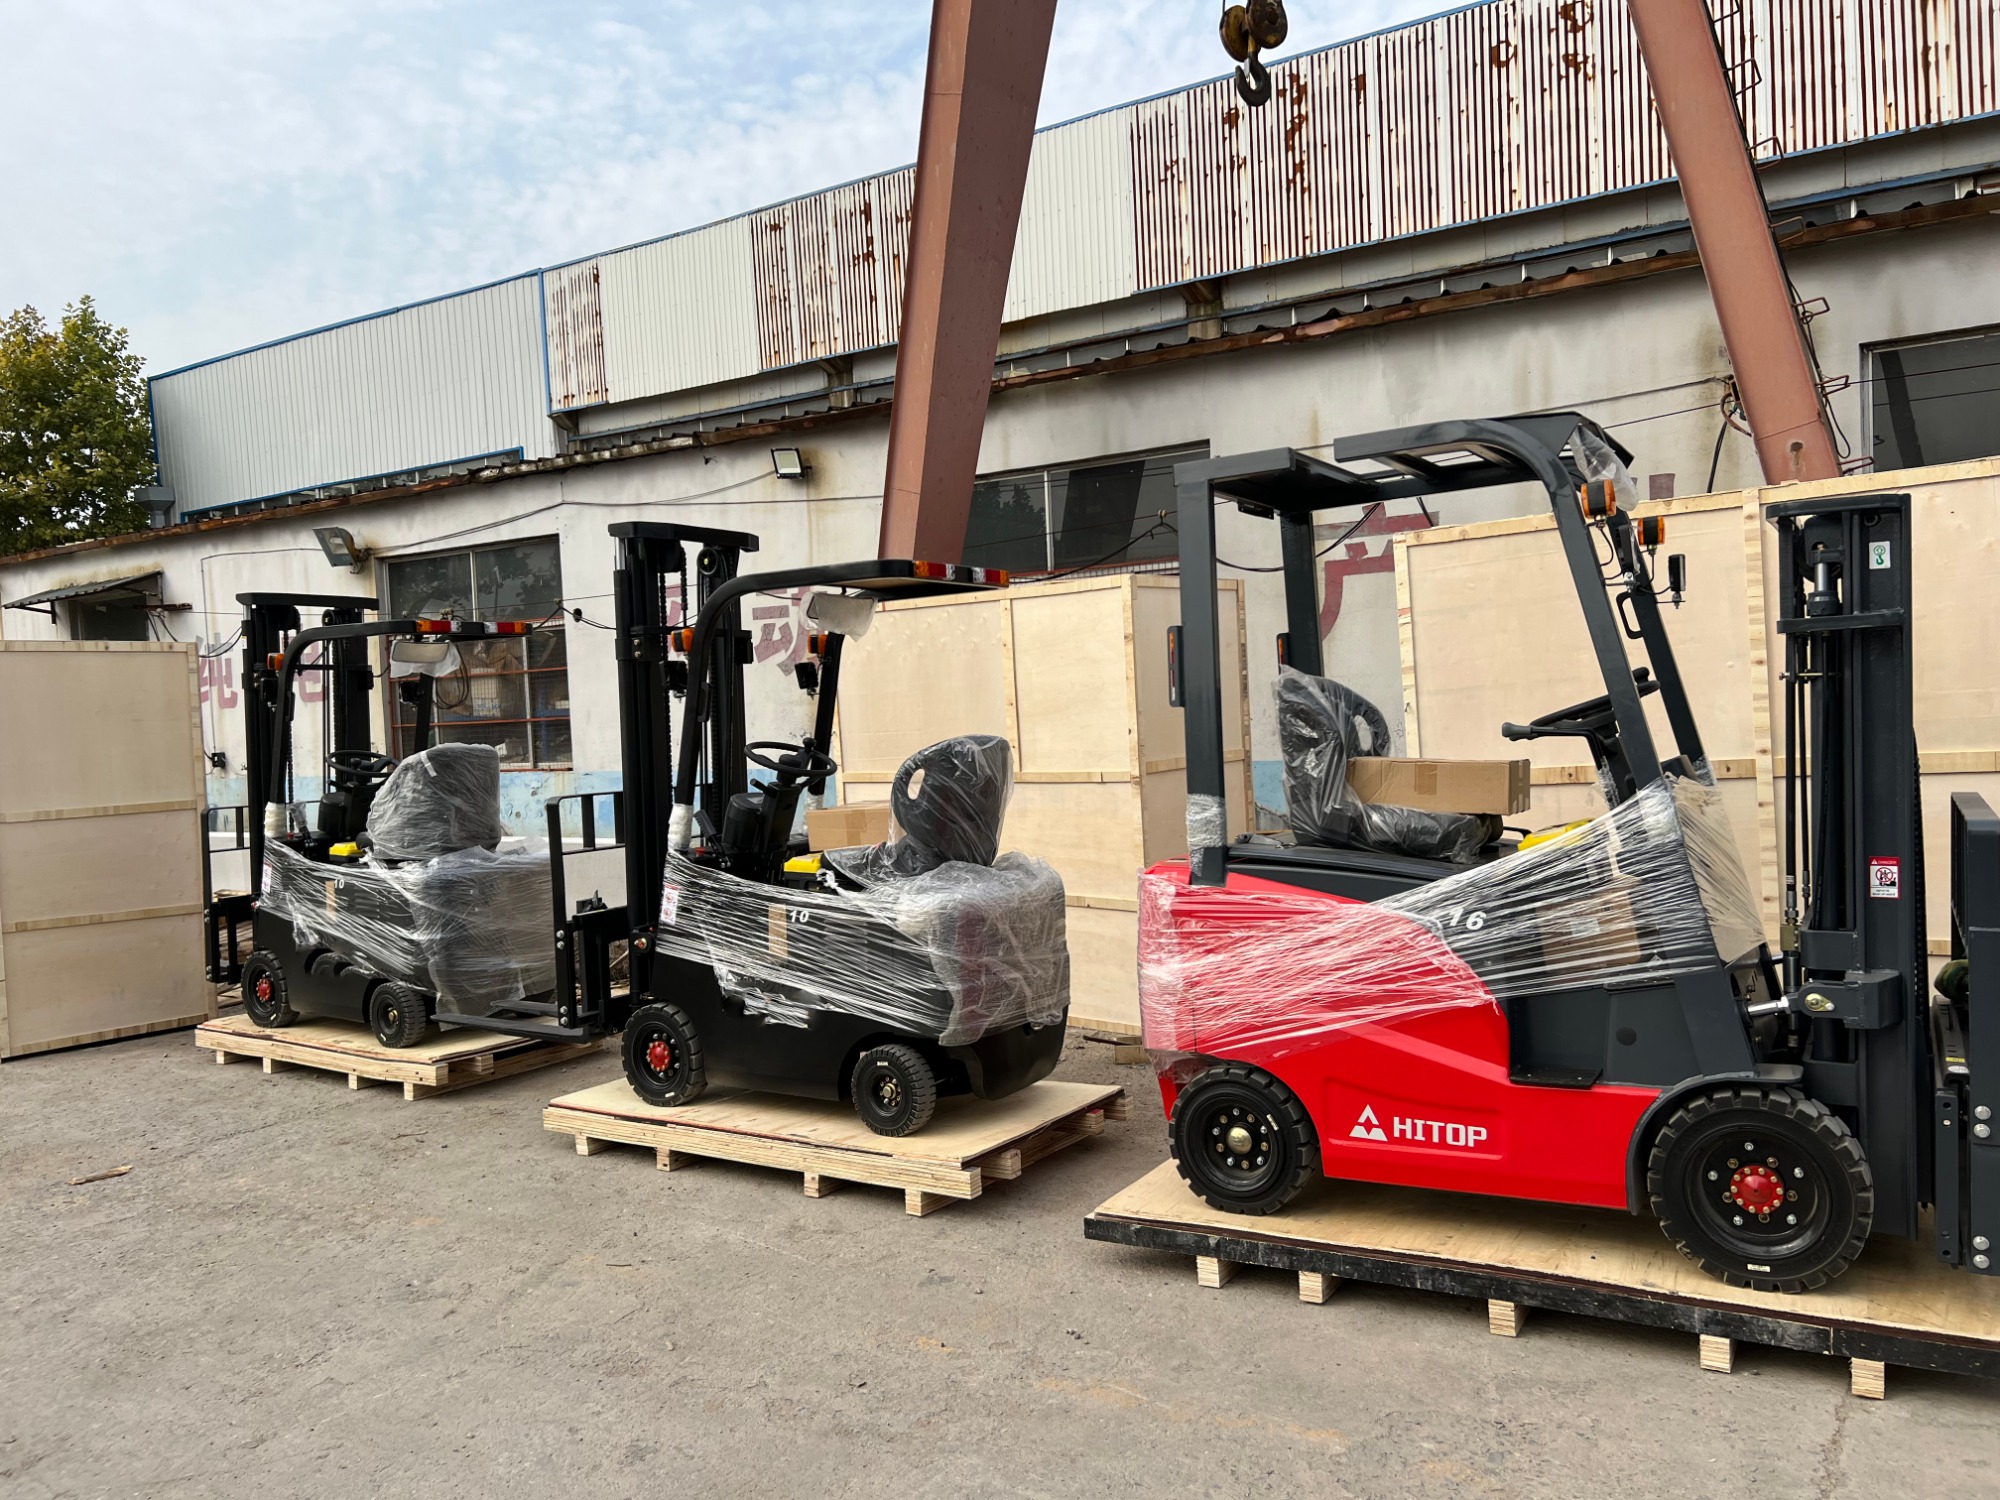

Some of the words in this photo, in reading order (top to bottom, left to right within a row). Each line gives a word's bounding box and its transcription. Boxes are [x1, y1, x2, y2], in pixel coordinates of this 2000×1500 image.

[334, 879, 345, 889] 10
[790, 910, 810, 923] 10
[1449, 908, 1487, 931] 16
[1393, 1115, 1487, 1147] HITOP
